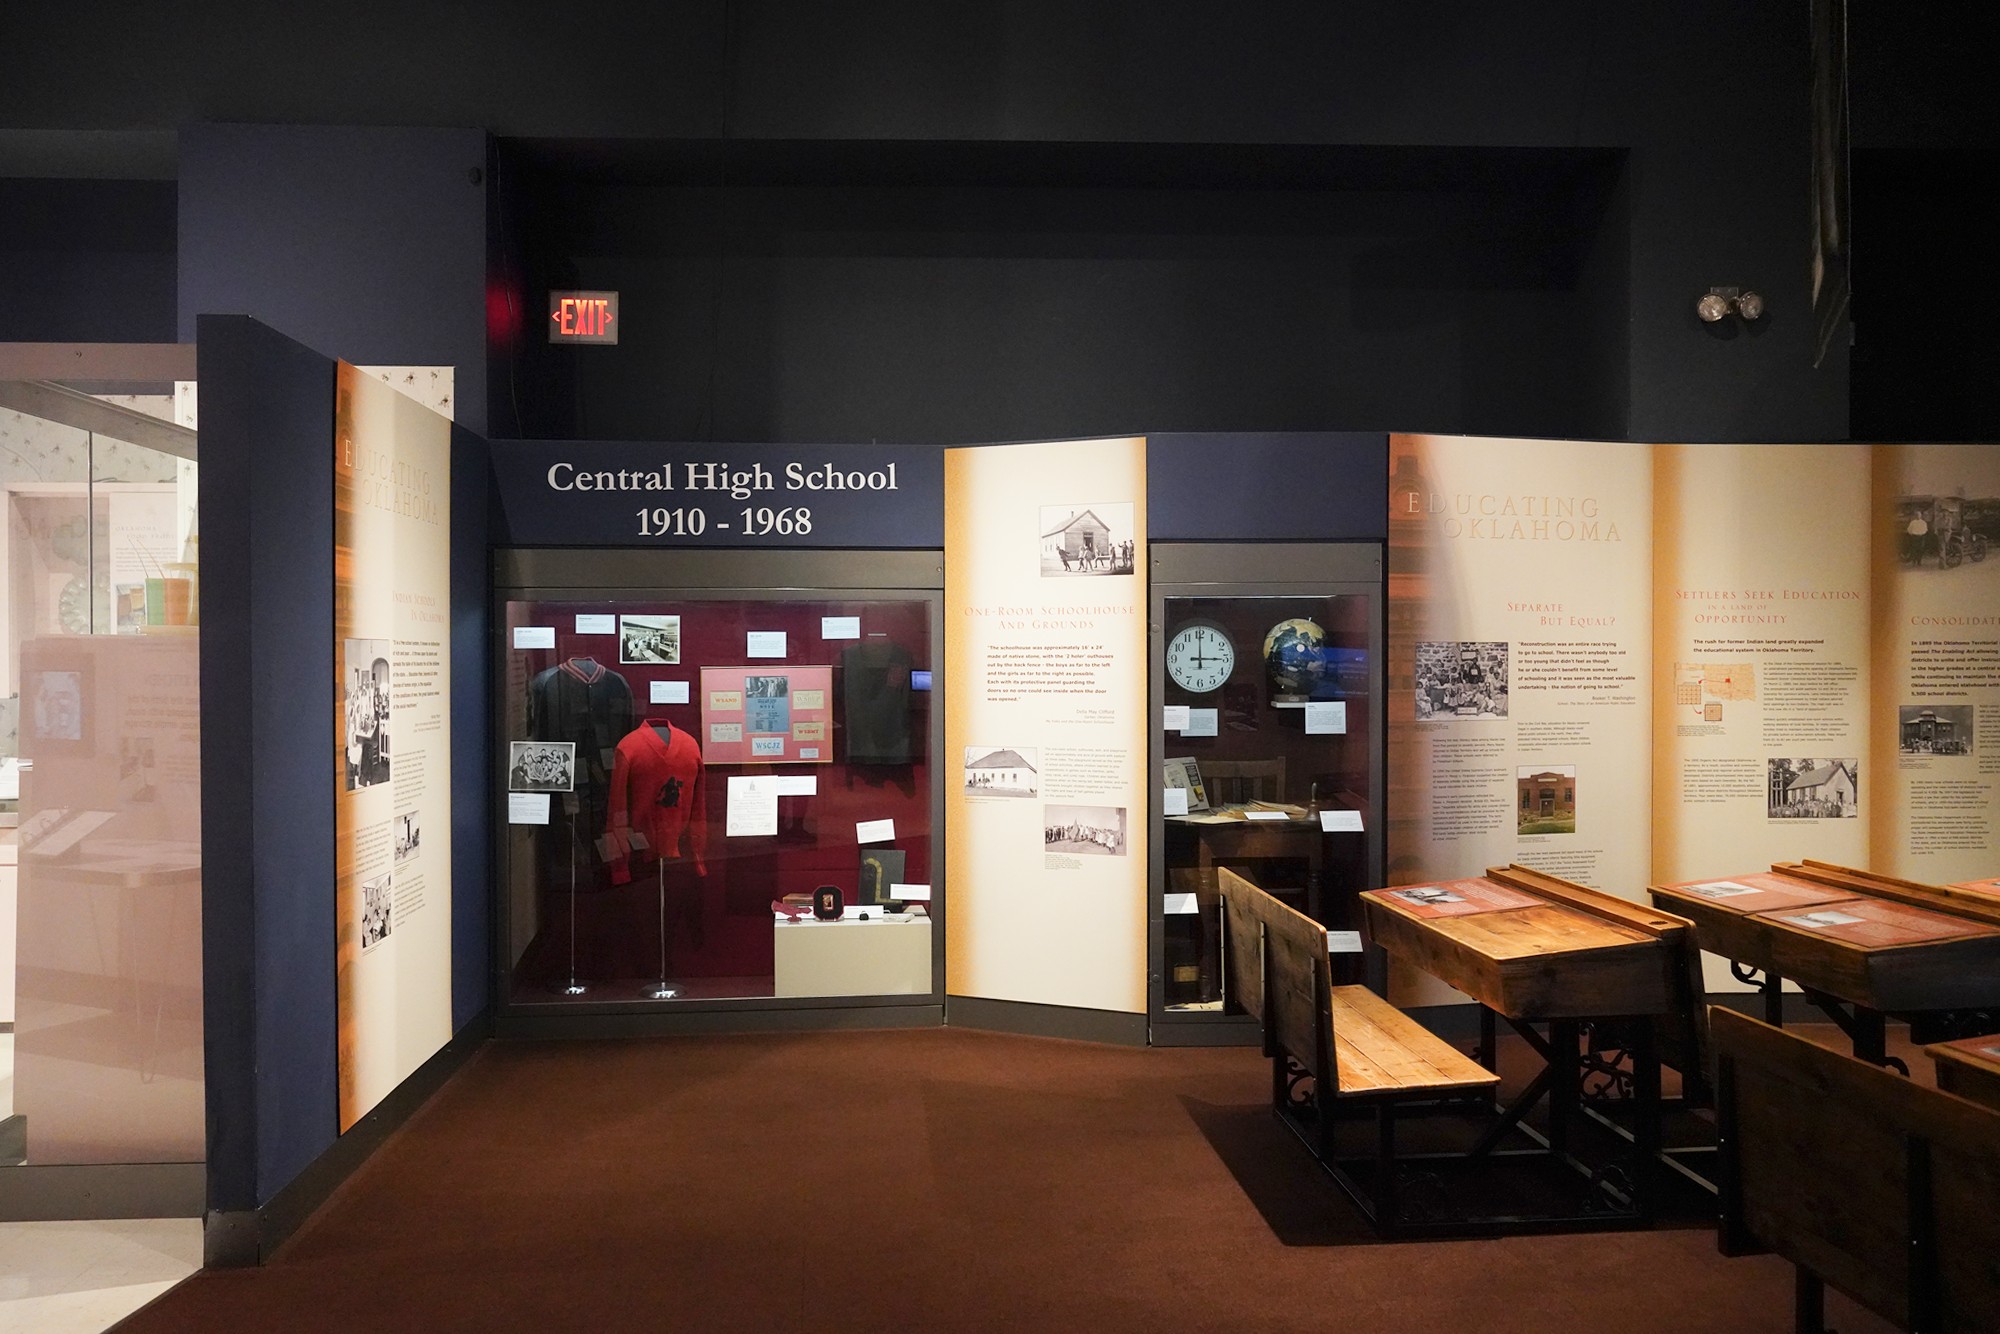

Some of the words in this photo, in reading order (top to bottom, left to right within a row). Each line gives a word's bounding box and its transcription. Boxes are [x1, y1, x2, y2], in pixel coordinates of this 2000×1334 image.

[561, 299, 608, 335] EXIT
[548, 462, 674, 491] Central
[684, 462, 774, 500] High
[786, 462, 898, 491] School
[1408, 492, 1599, 518] EDUCATING
[636, 508, 706, 536] 1910
[740, 508, 812, 536] 1968
[1444, 518, 1622, 542] OKLAHOMA
[1676, 590, 1736, 600] SETTLERS
[1744, 590, 1774, 600] SEEK
[1784, 590, 1860, 600] EDUCATION
[964, 606, 1033, 616] ONE-ROOM
[1042, 606, 1134, 616] SCHOOLHOUSE
[1508, 602, 1563, 612] SEPARATE
[1541, 616, 1562, 626] BUT
[1570, 616, 1616, 628] EQUAL?
[1695, 614, 1787, 624] OPPORTUNITY
[998, 620, 1024, 630] AND
[1032, 620, 1094, 630] GROUNDS
[1184, 634, 1191, 642] 11
[1175, 643, 1184, 652] 10
[1219, 642, 1225, 651] 2
[1171, 654, 1177, 663] 9
[1222, 654, 1228, 663] 3
[1175, 667, 1182, 676] 8
[1186, 676, 1192, 685] 7
[1197, 679, 1203, 688] 6
[1210, 676, 1215, 684] 5
